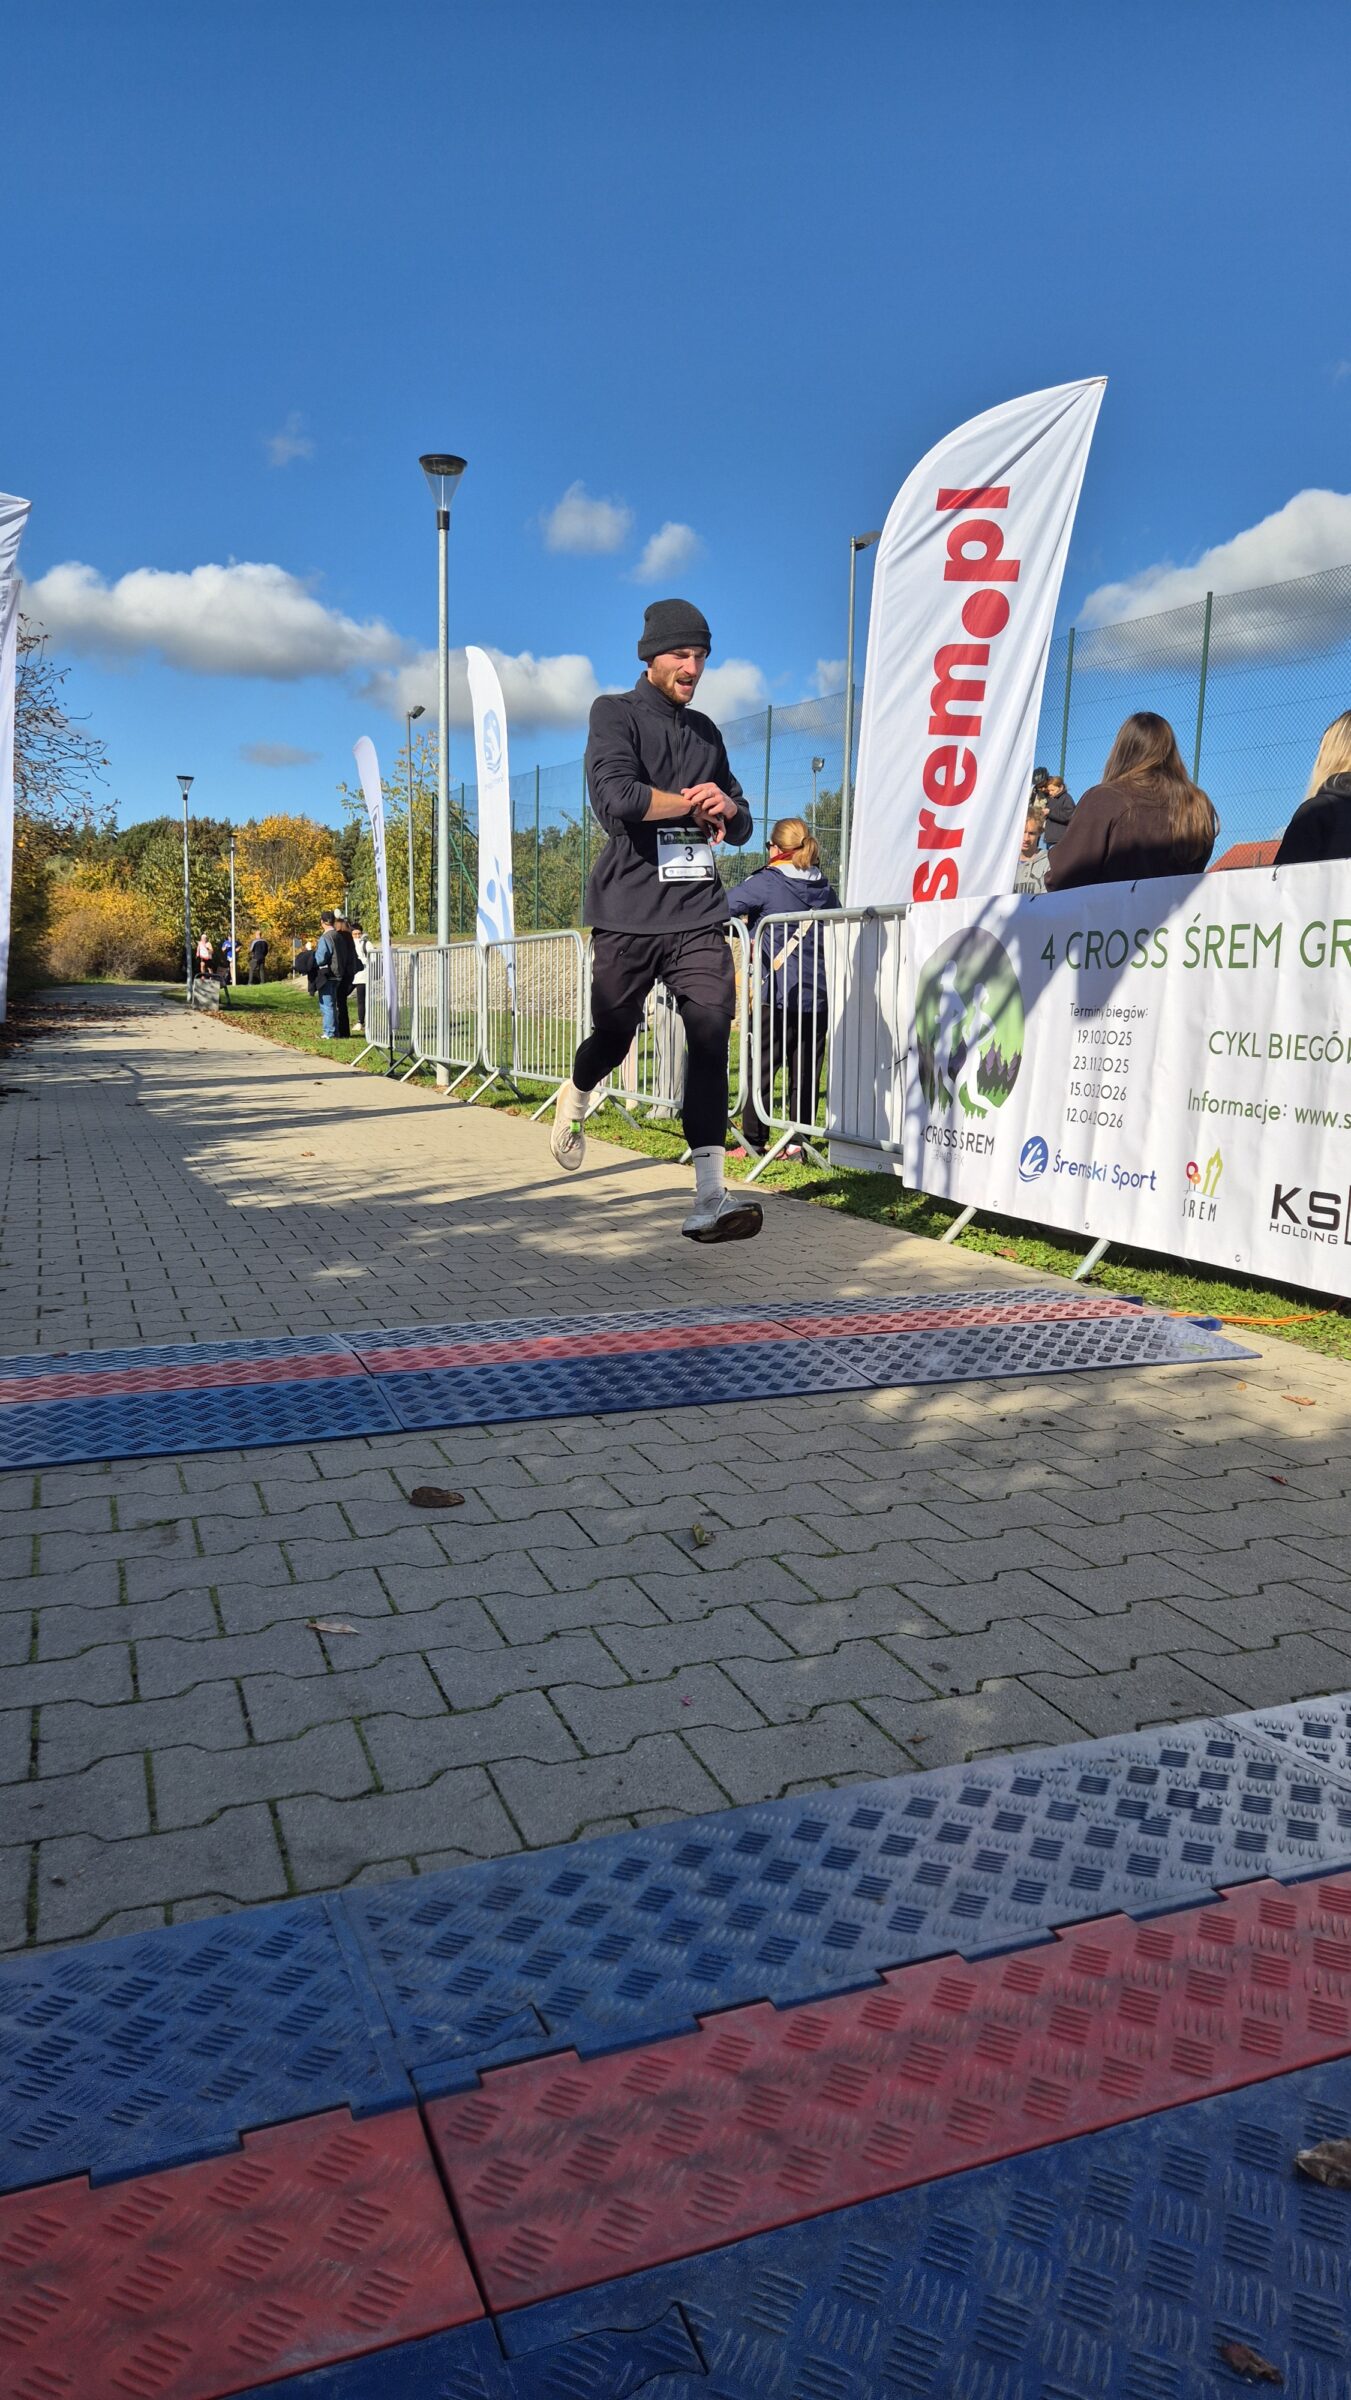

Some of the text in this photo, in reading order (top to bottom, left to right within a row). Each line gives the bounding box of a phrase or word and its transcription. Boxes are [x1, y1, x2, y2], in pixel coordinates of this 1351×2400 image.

[684, 846, 695, 862] 3
[1041, 913, 1351, 971] 4 CROSS ŚREM GR
[1070, 1002, 1148, 1022] Terminy biegów:
[1208, 1030, 1351, 1064] CYKL BIEGÓ
[1187, 1088, 1287, 1125] Informacje:
[925, 1125, 957, 1148] CROSS
[1053, 1149, 1157, 1191] Śremski Sport
[1271, 1183, 1342, 1232] KS
[1269, 1222, 1339, 1245] HOLDING
